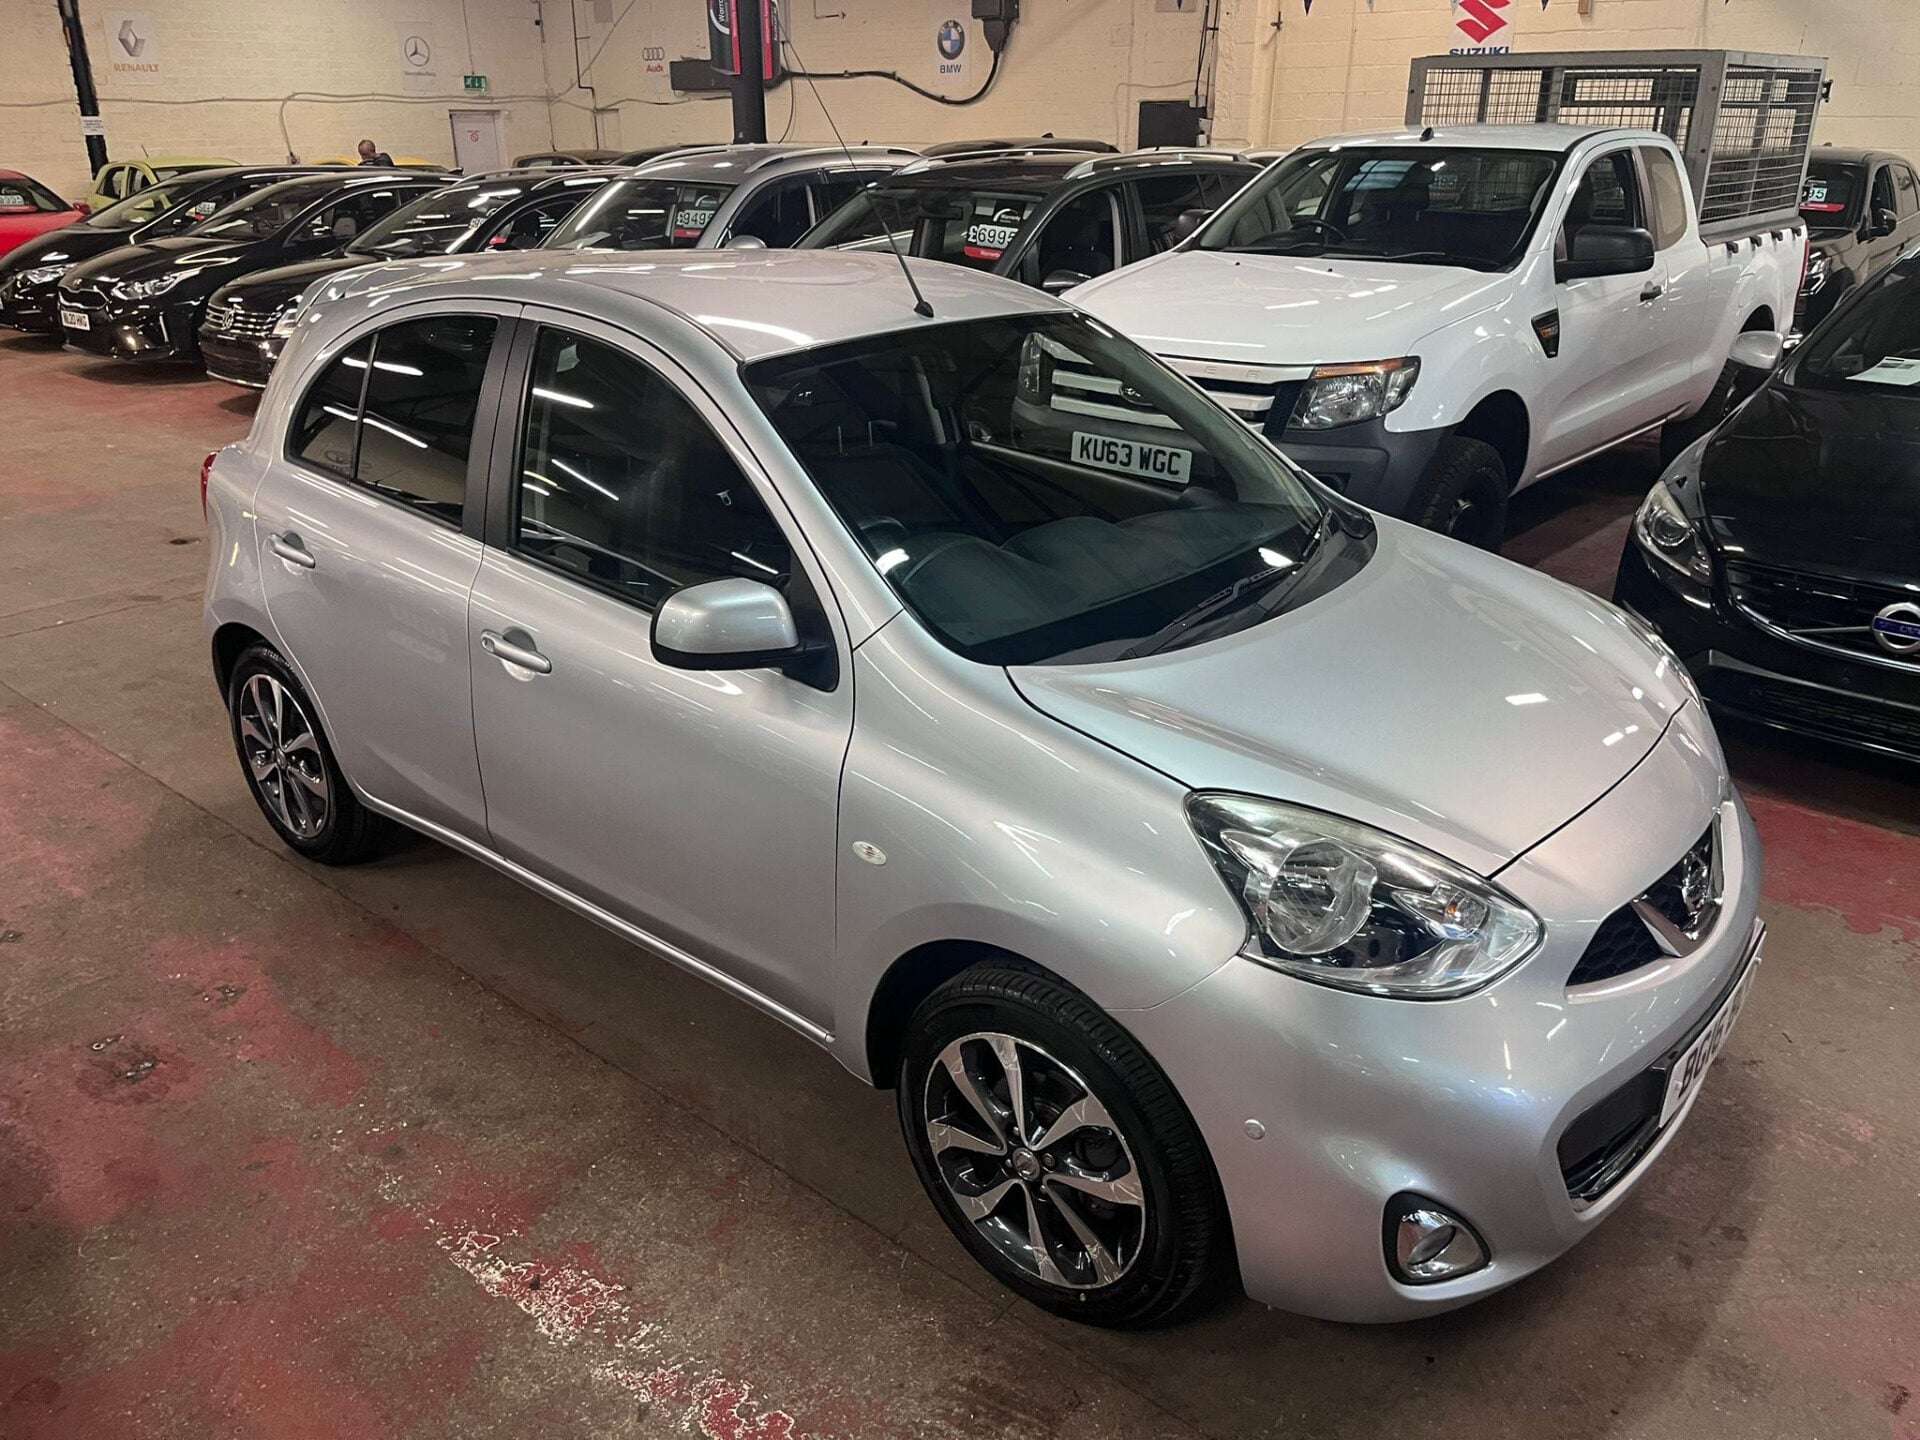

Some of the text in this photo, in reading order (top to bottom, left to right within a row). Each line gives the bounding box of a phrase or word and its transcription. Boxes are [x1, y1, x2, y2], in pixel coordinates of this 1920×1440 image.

[1449, 46, 1509, 57] SUZUKI
[113, 63, 160, 73] RENAULT
[940, 63, 962, 74] BMW
[1080, 436, 1182, 476] KU63 WGC
